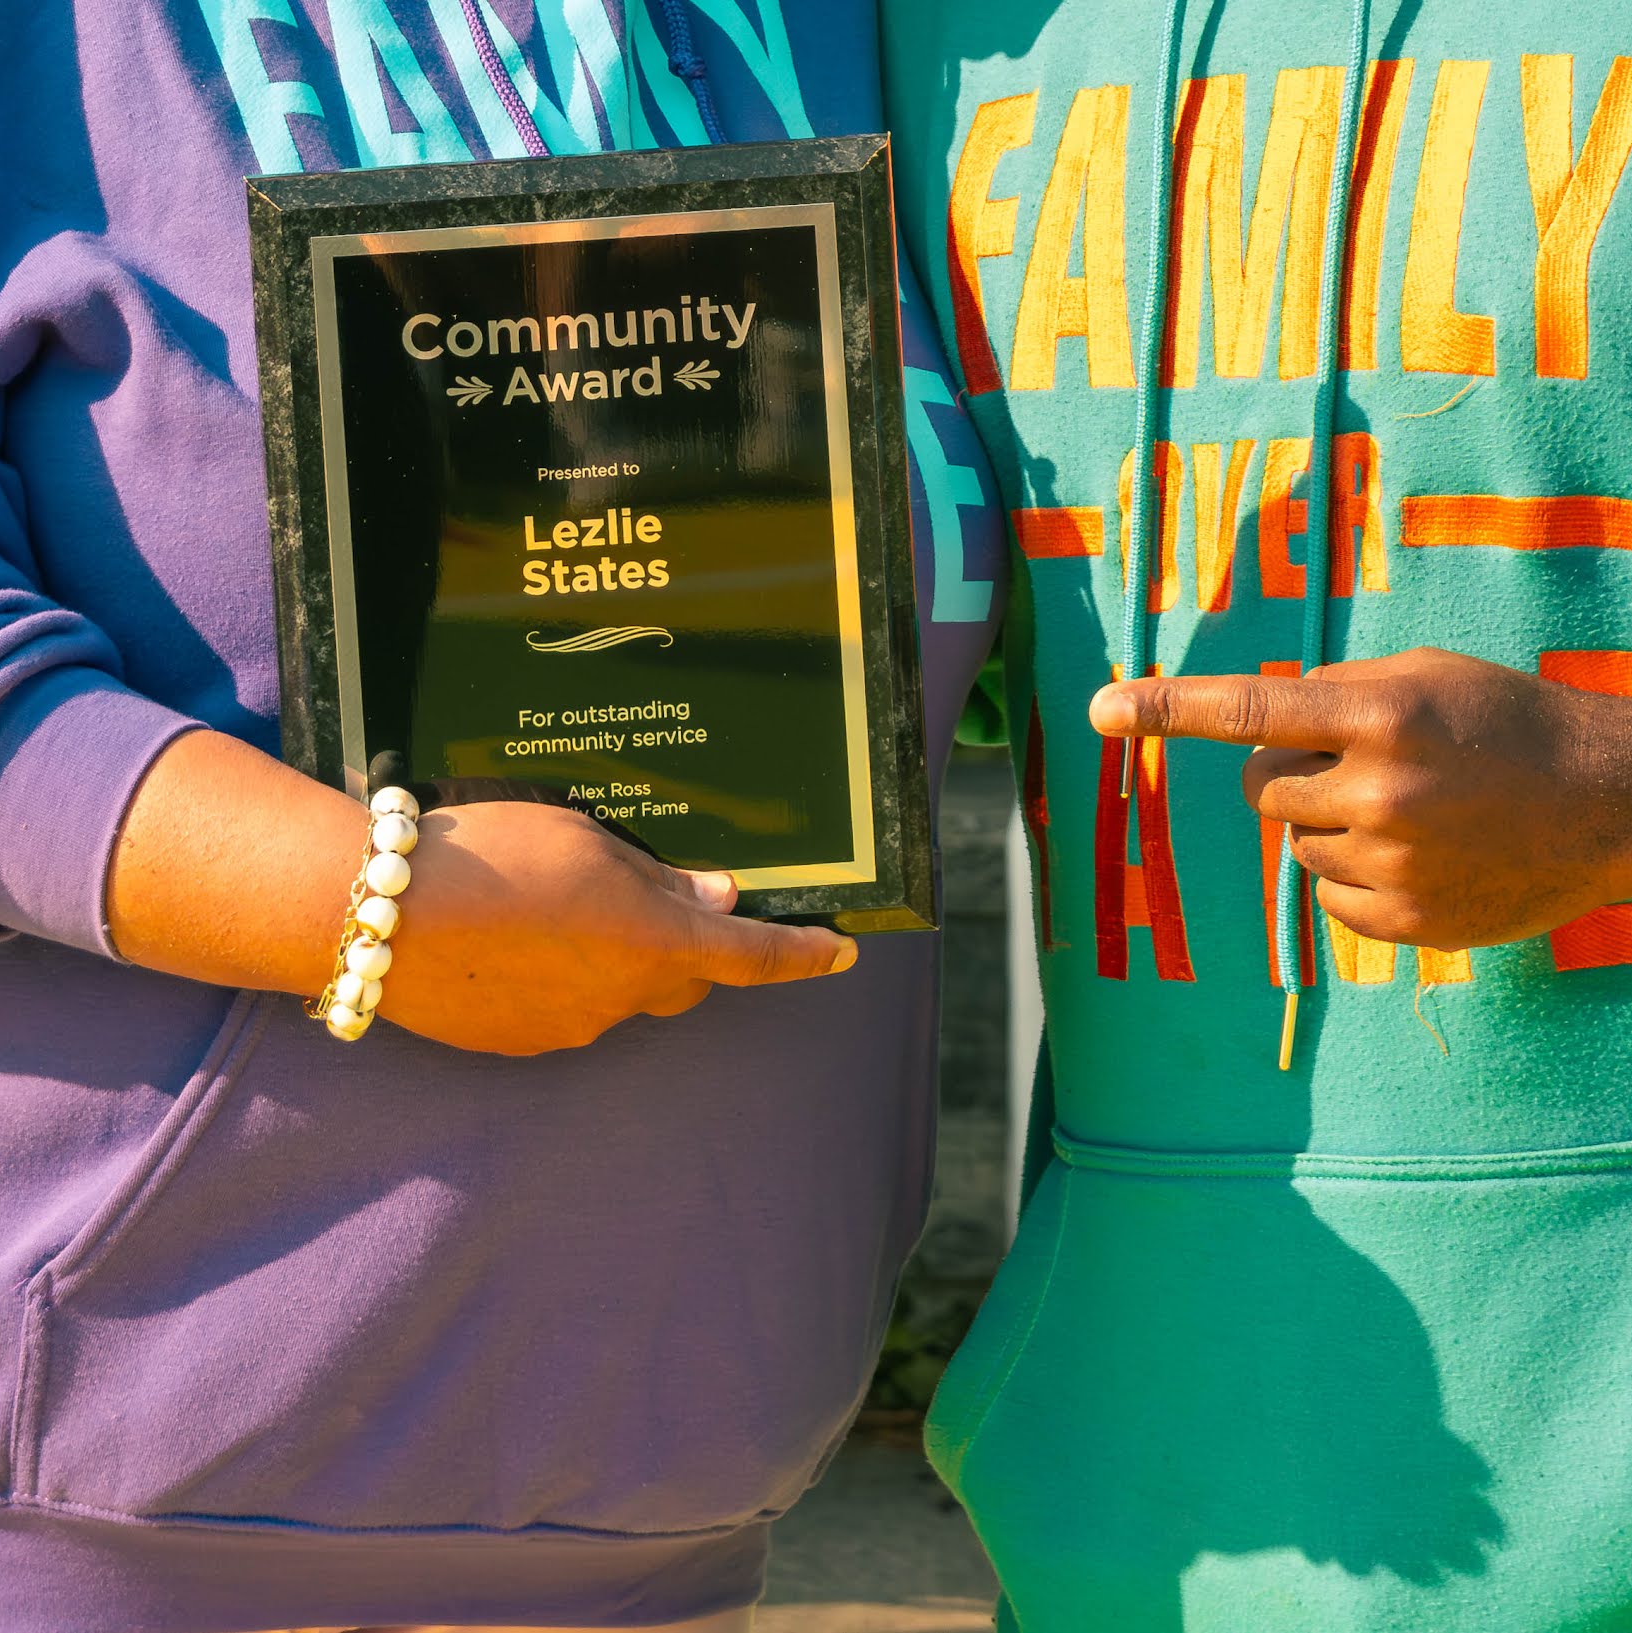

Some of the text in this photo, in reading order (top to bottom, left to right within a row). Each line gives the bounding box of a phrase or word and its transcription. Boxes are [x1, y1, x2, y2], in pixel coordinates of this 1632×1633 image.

[402, 295, 757, 360] Community
[502, 356, 662, 406] Award
[537, 462, 640, 481] Presented to
[524, 507, 663, 551] Lezlie
[1119, 433, 1390, 613] OVER
[522, 557, 670, 596] States
[518, 700, 690, 729] For outstanding
[504, 725, 709, 756] community service
[567, 782, 652, 801] Alex Ross
[594, 804, 637, 820] Over
[641, 801, 690, 817] Fame
